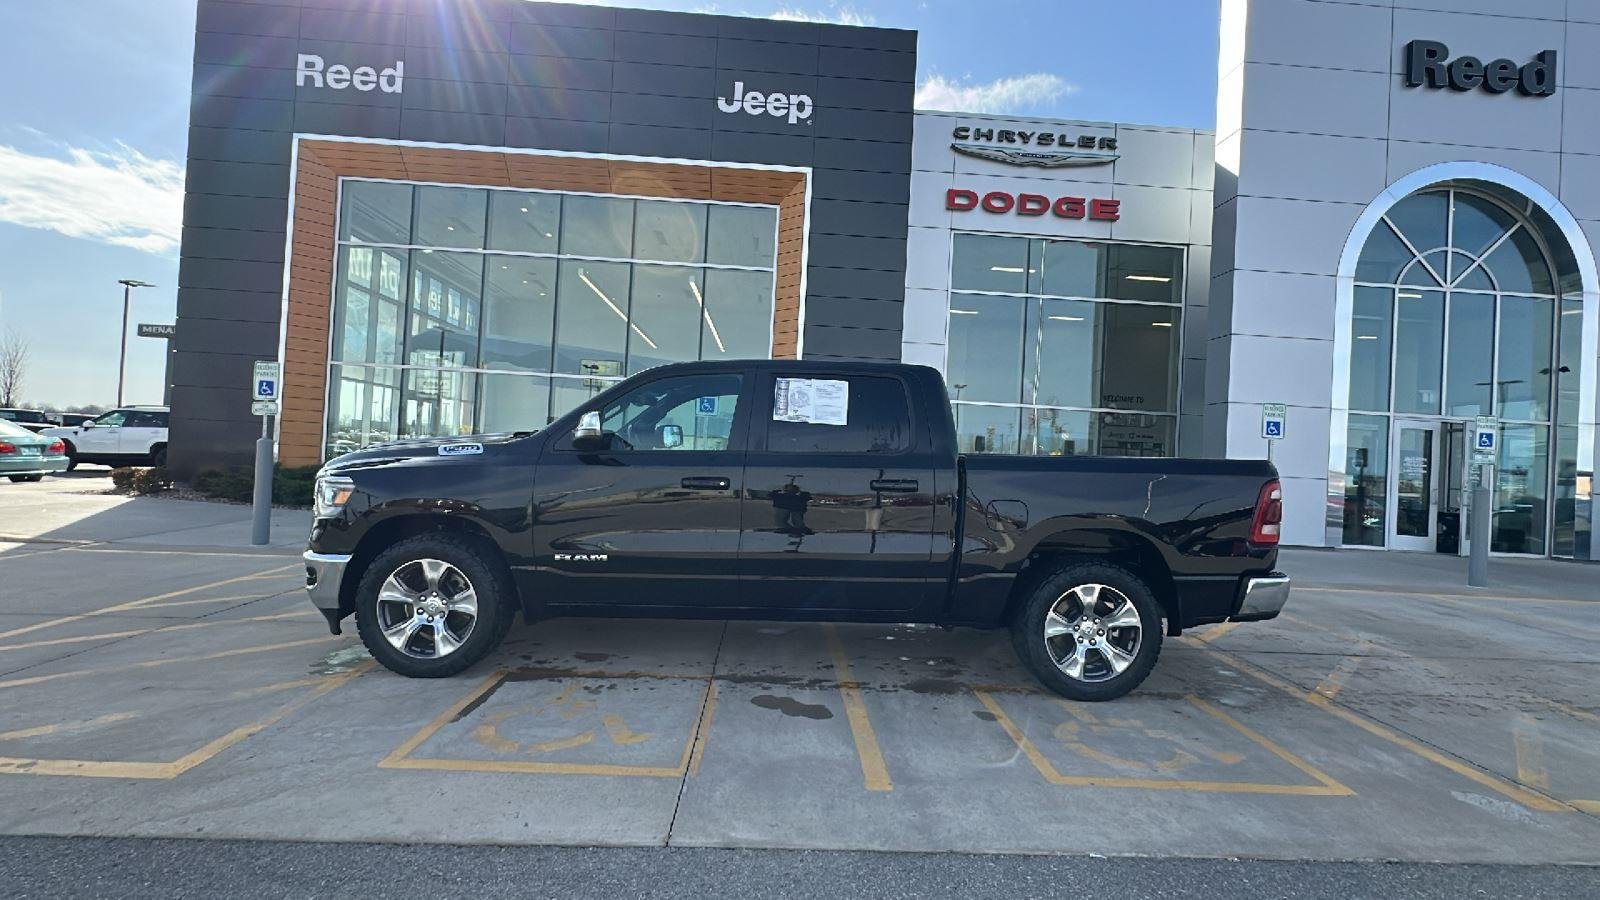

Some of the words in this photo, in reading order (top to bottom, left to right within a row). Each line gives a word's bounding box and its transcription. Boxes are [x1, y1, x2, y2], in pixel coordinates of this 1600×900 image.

[296, 53, 404, 94] Reed
[1405, 39, 1558, 98] Reed
[717, 81, 813, 124] Jeep
[953, 126, 1118, 150] CHRYSLER
[946, 188, 1121, 222] DODGE
[142, 325, 176, 334] MENA
[554, 553, 608, 561] RAM
